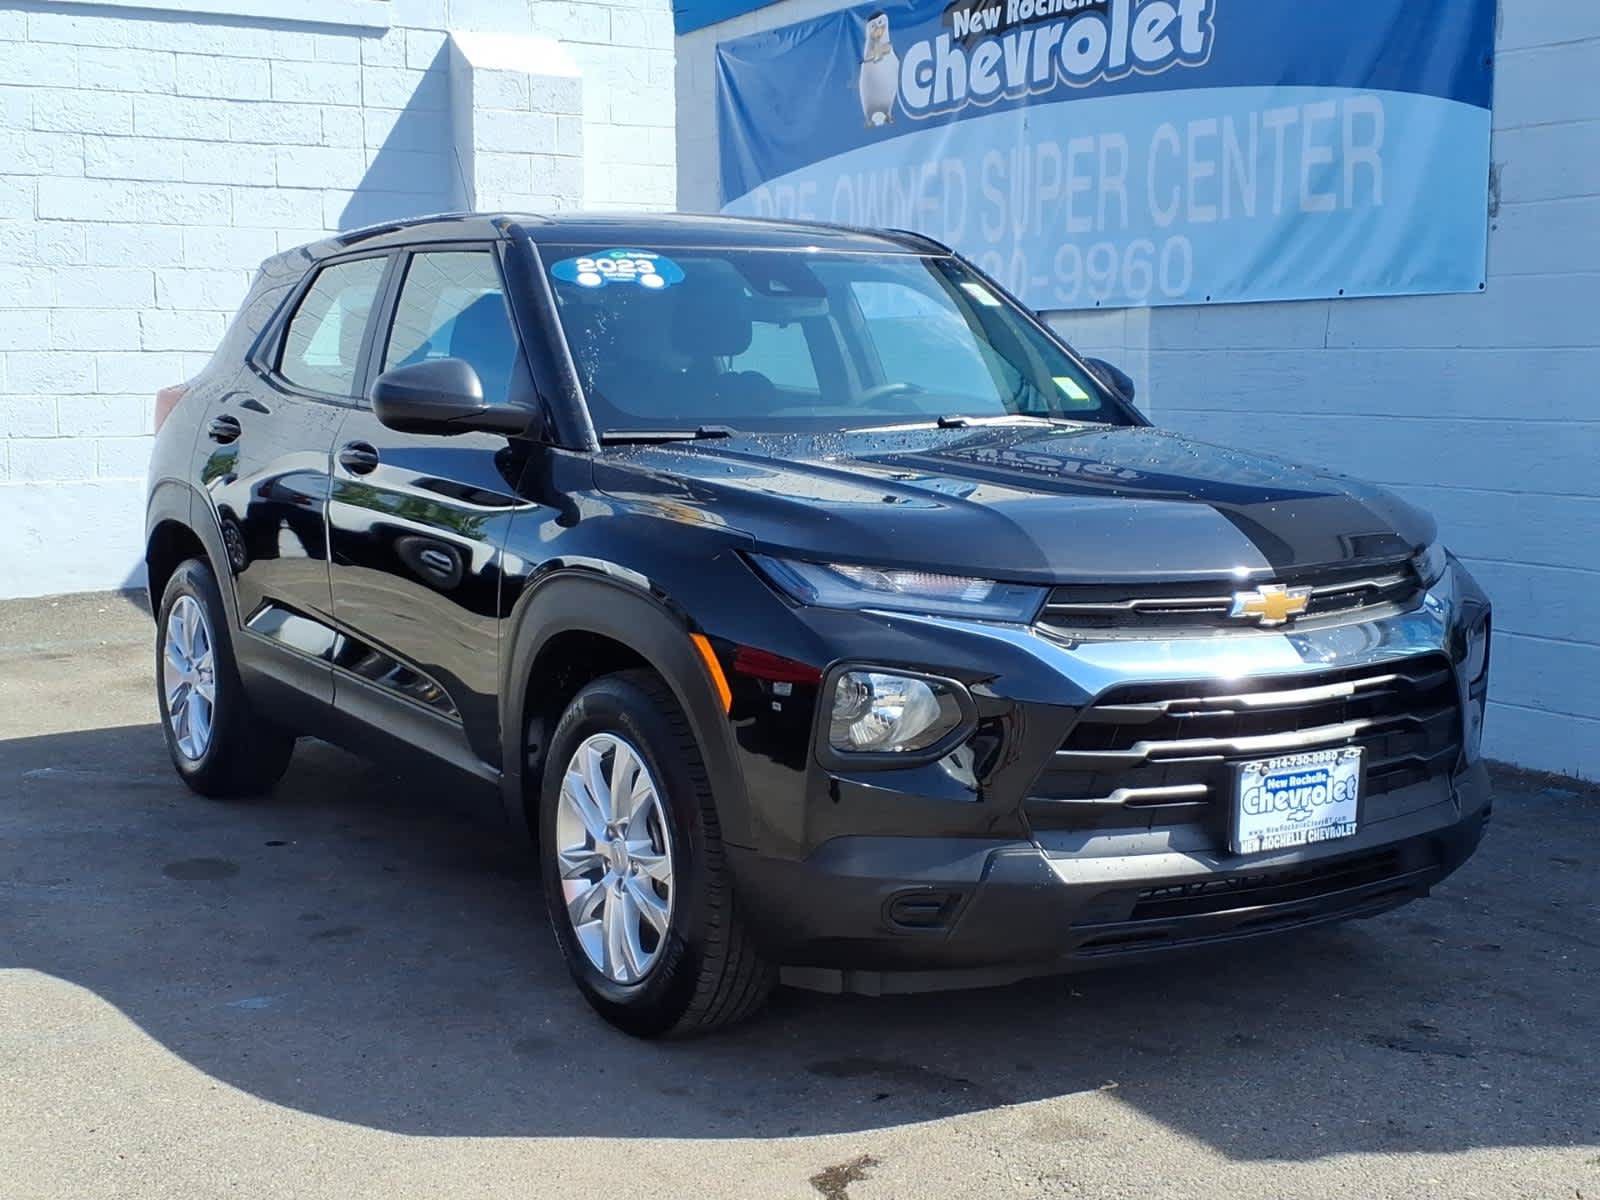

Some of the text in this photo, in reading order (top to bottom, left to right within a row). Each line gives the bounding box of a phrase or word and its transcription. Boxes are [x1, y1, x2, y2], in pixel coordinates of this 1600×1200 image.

[952, 0, 1105, 38] New Roche
[899, 0, 1207, 109] Chevrolet
[981, 132, 1129, 244] SUPER
[1146, 95, 1385, 228] CENTER
[575, 257, 656, 274] 2023
[1242, 774, 1357, 815] Chevrolet
[1266, 771, 1328, 790] New Rochelle
[1240, 823, 1357, 855] NEW ROCHELLE CHEVROLET
